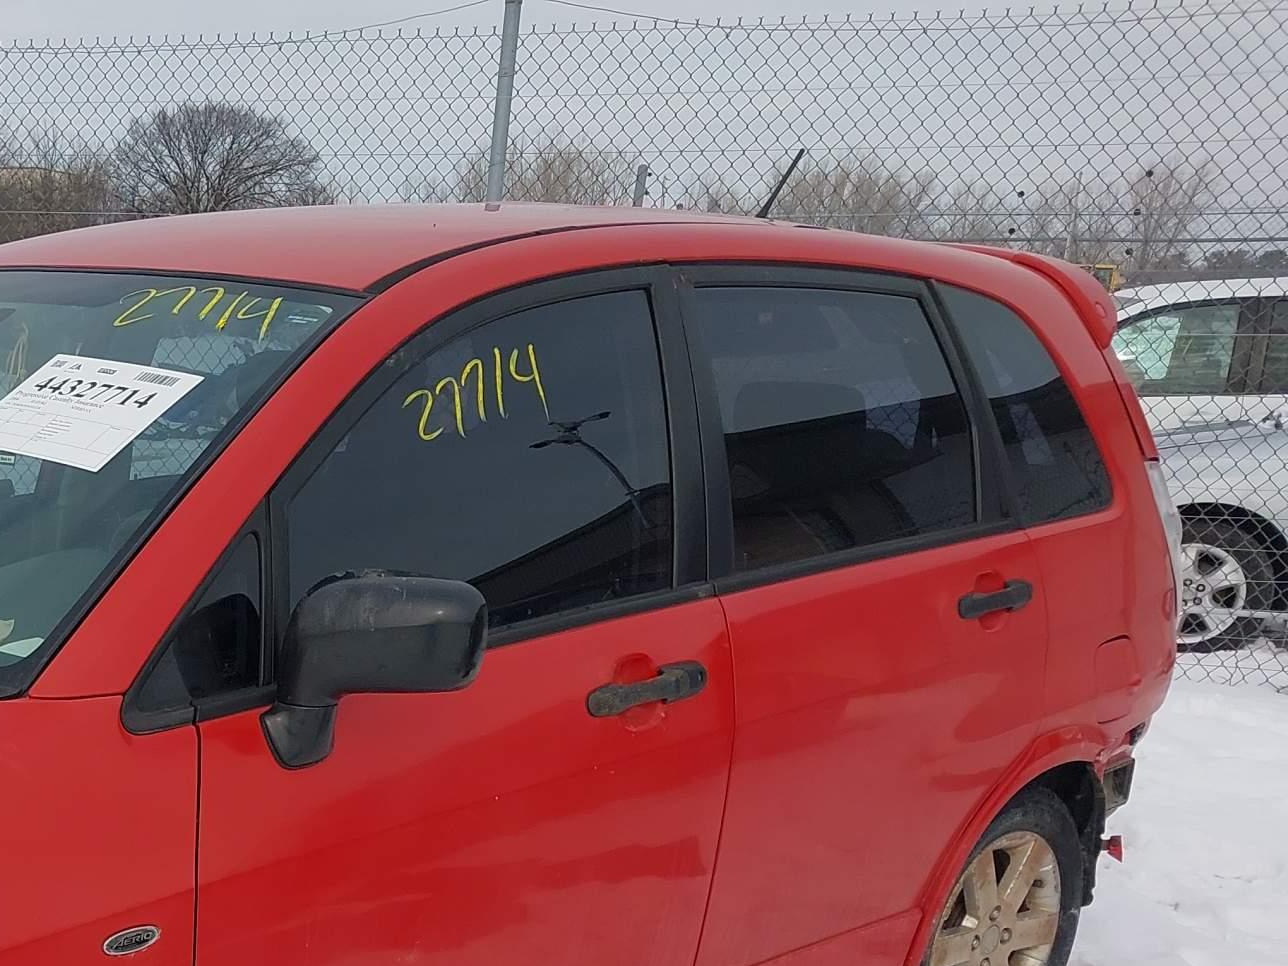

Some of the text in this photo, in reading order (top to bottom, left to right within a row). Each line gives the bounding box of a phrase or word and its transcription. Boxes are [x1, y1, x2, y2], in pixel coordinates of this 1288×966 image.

[112, 286, 284, 344] 27714
[34, 375, 158, 409] 44327714
[401, 343, 551, 441] 27714
[112, 931, 154, 950] AERIO
